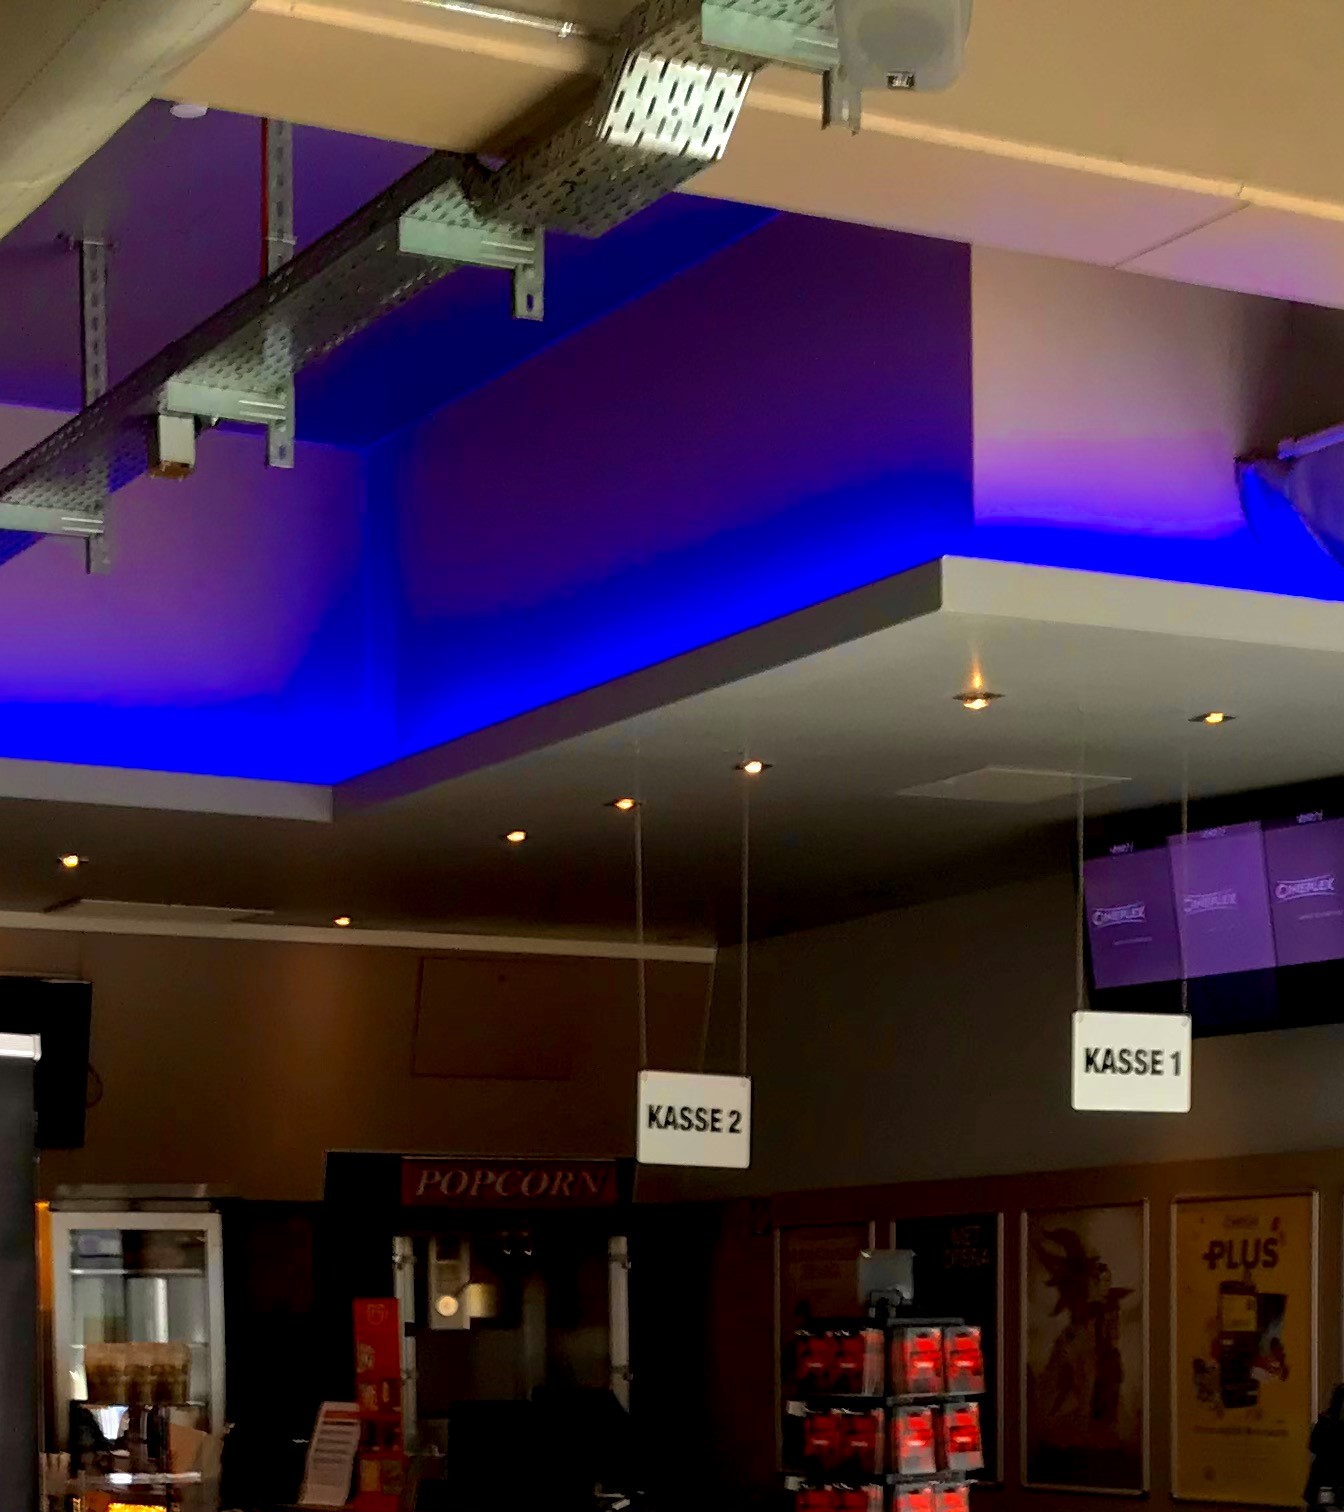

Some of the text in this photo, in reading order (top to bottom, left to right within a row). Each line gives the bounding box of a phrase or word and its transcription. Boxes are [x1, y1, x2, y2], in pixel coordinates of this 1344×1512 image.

[1084, 1047, 1182, 1077] KASSE 1
[648, 1104, 743, 1134] KASSE 2
[415, 1169, 605, 1197] POPCORN
[1203, 1237, 1279, 1270] PLUS
